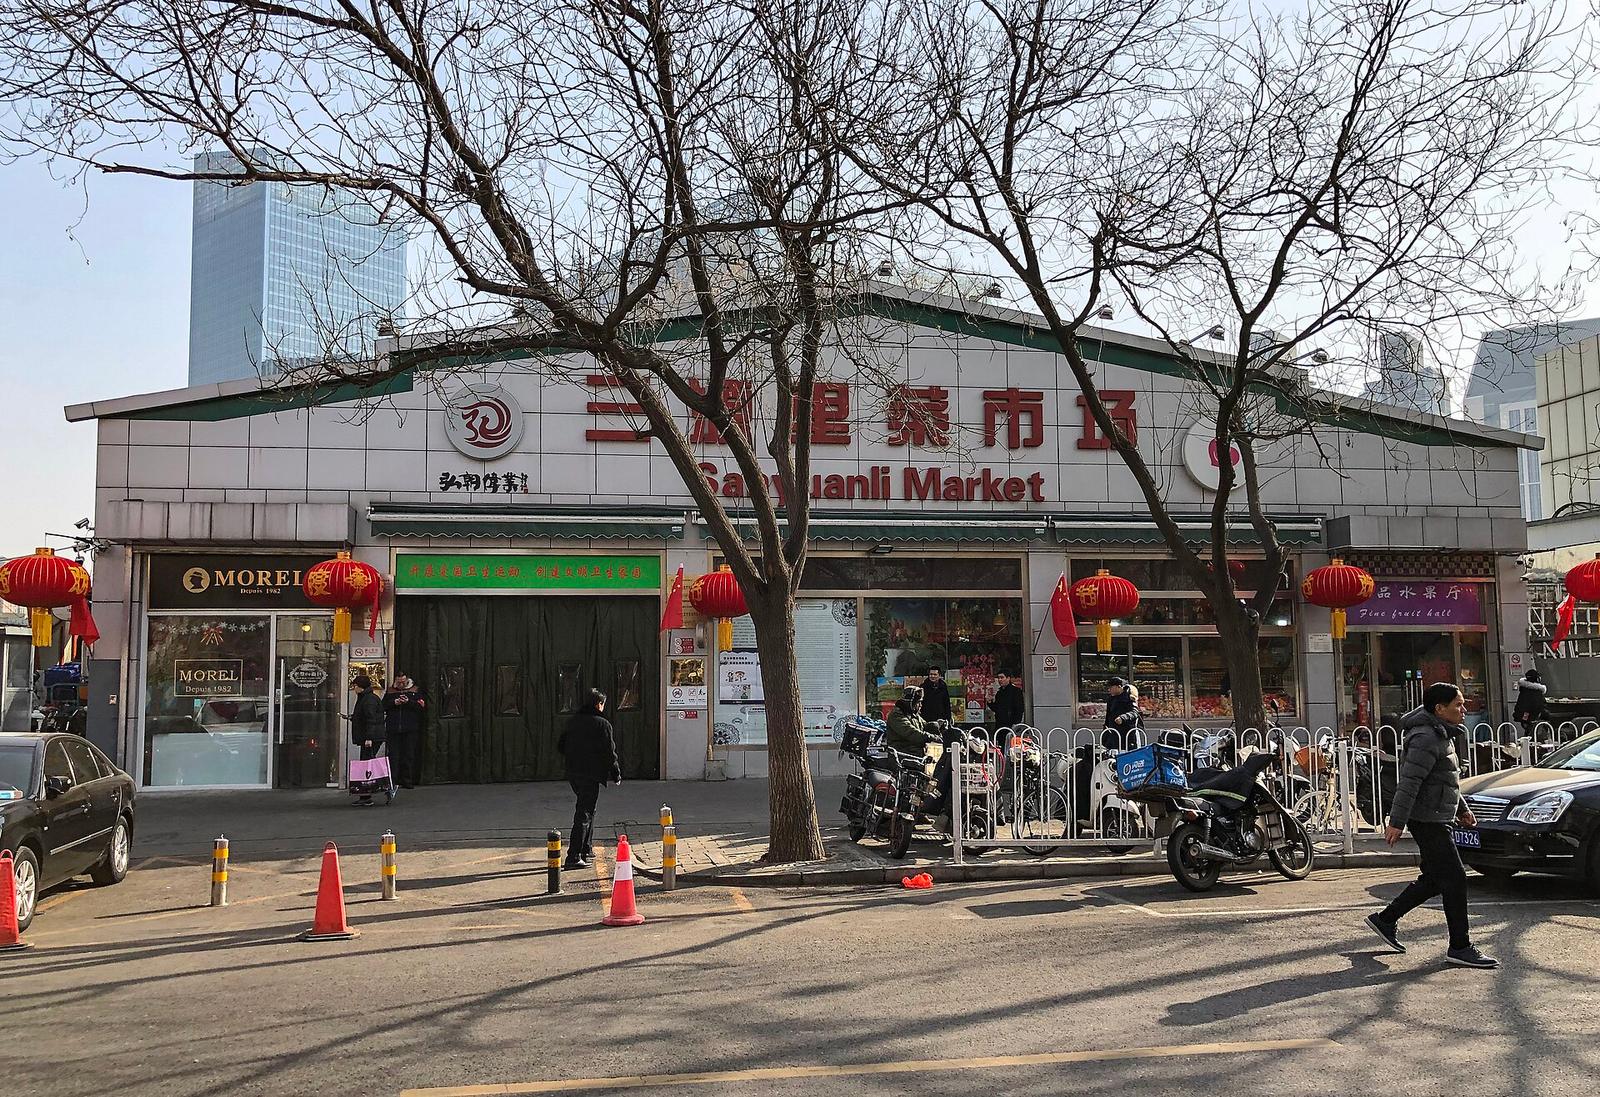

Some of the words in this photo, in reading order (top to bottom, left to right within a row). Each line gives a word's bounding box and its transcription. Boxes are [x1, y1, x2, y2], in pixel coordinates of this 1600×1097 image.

[903, 467, 1046, 501] Market
[214, 569, 304, 587] MOREL
[1377, 585, 1461, 600] 品水果厅
[1359, 608, 1386, 618] Fine
[1391, 609, 1422, 620] fruit
[1426, 608, 1452, 617] hall
[179, 669, 239, 682] MOREL
[185, 686, 210, 694] Depuis
